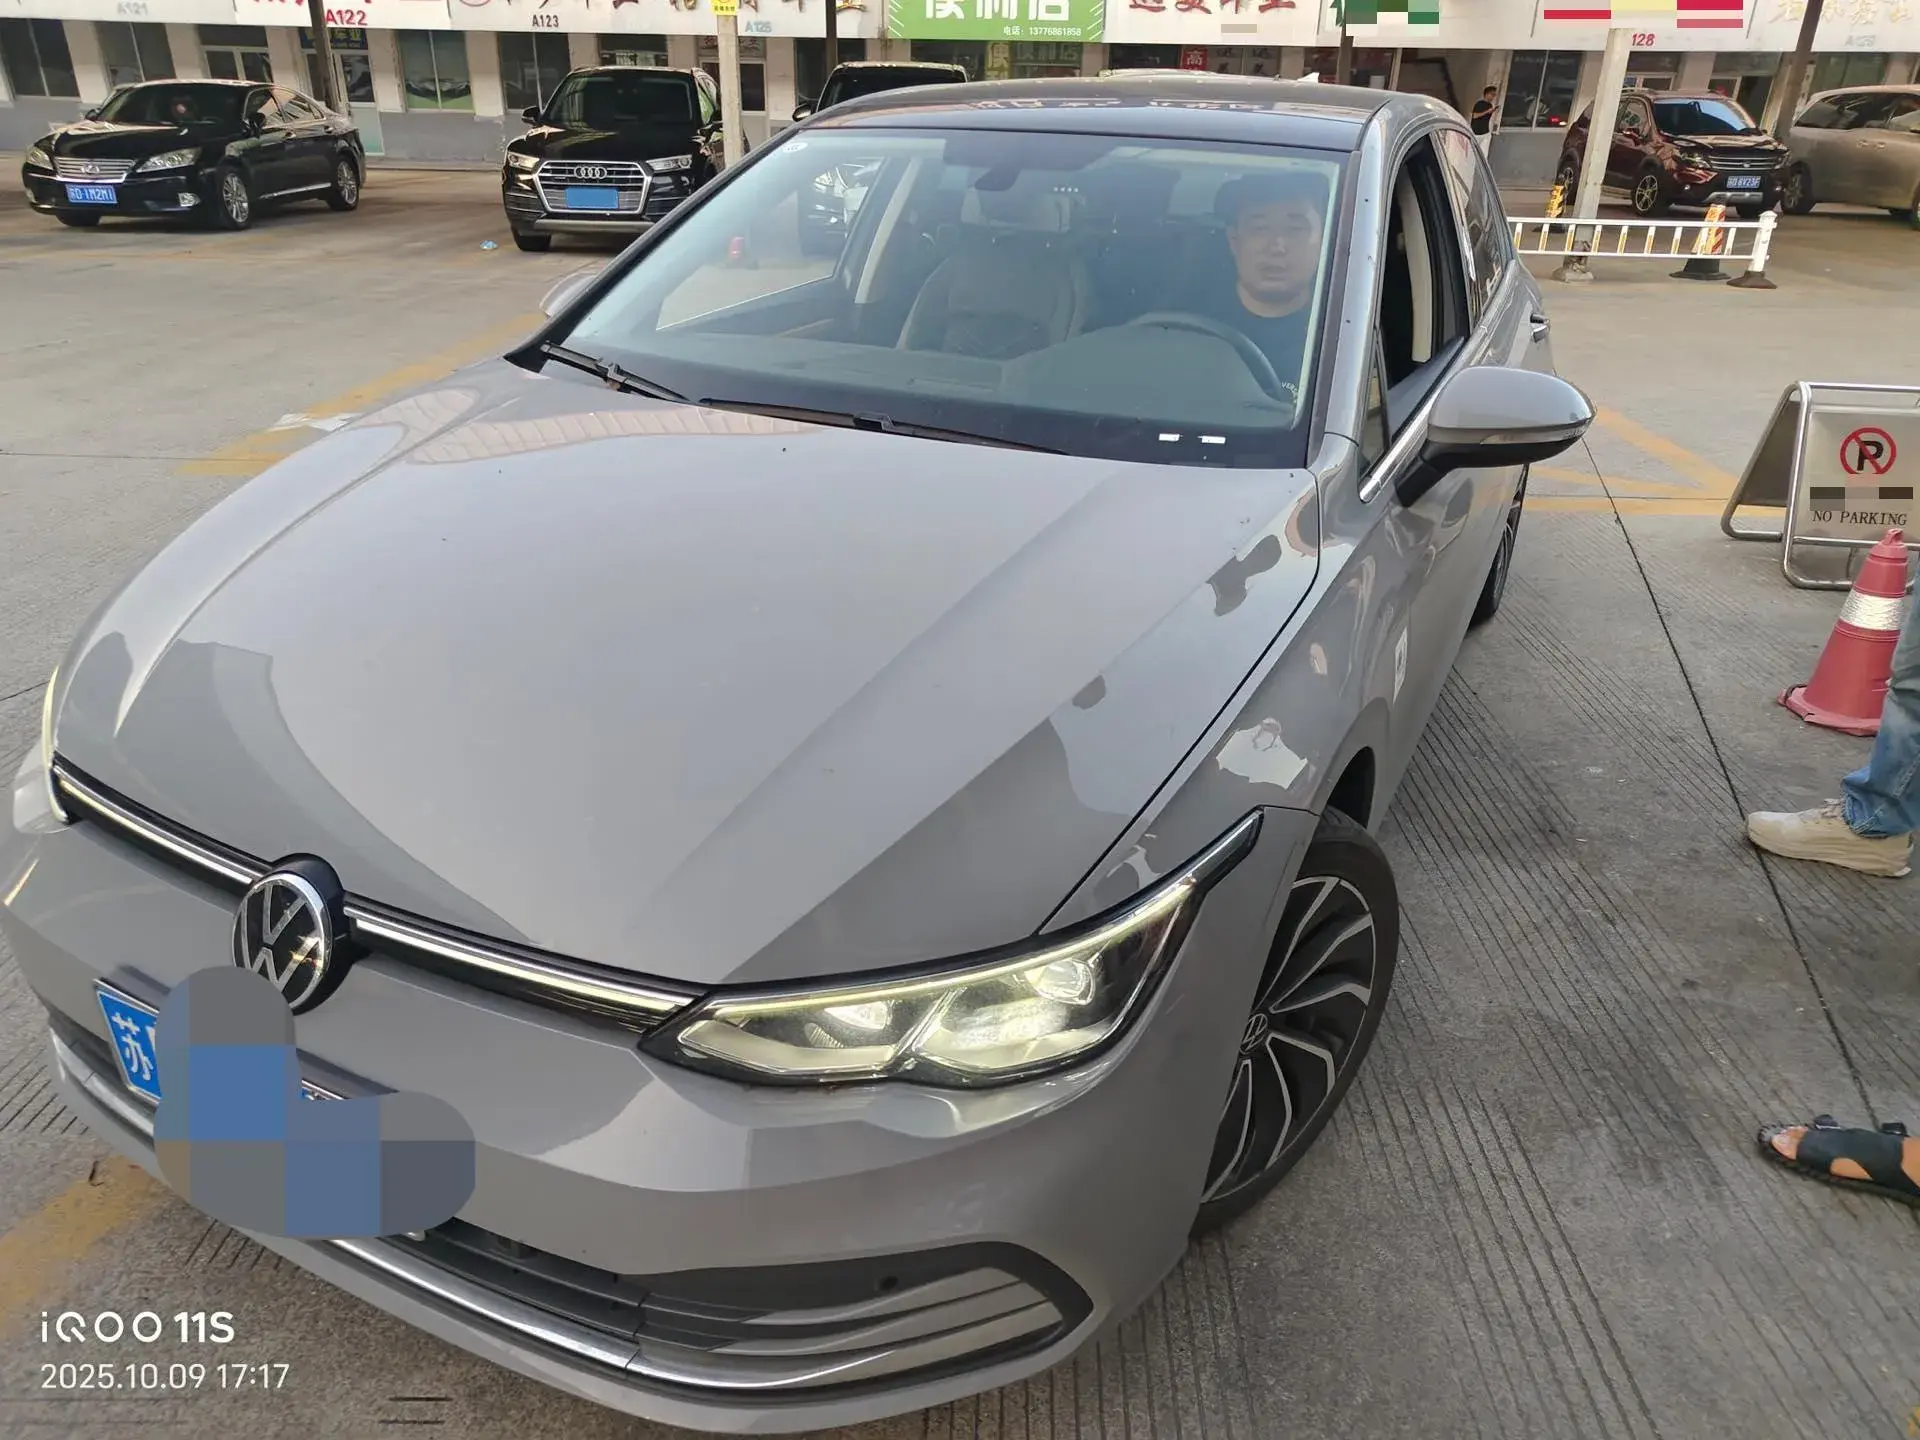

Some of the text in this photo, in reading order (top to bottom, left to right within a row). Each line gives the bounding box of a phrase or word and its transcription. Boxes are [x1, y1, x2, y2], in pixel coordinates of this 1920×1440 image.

[325, 9, 368, 26] A122
[532, 14, 560, 28] A123
[1632, 33, 1656, 47] 128
[1813, 510, 1908, 526] NO PARKING
